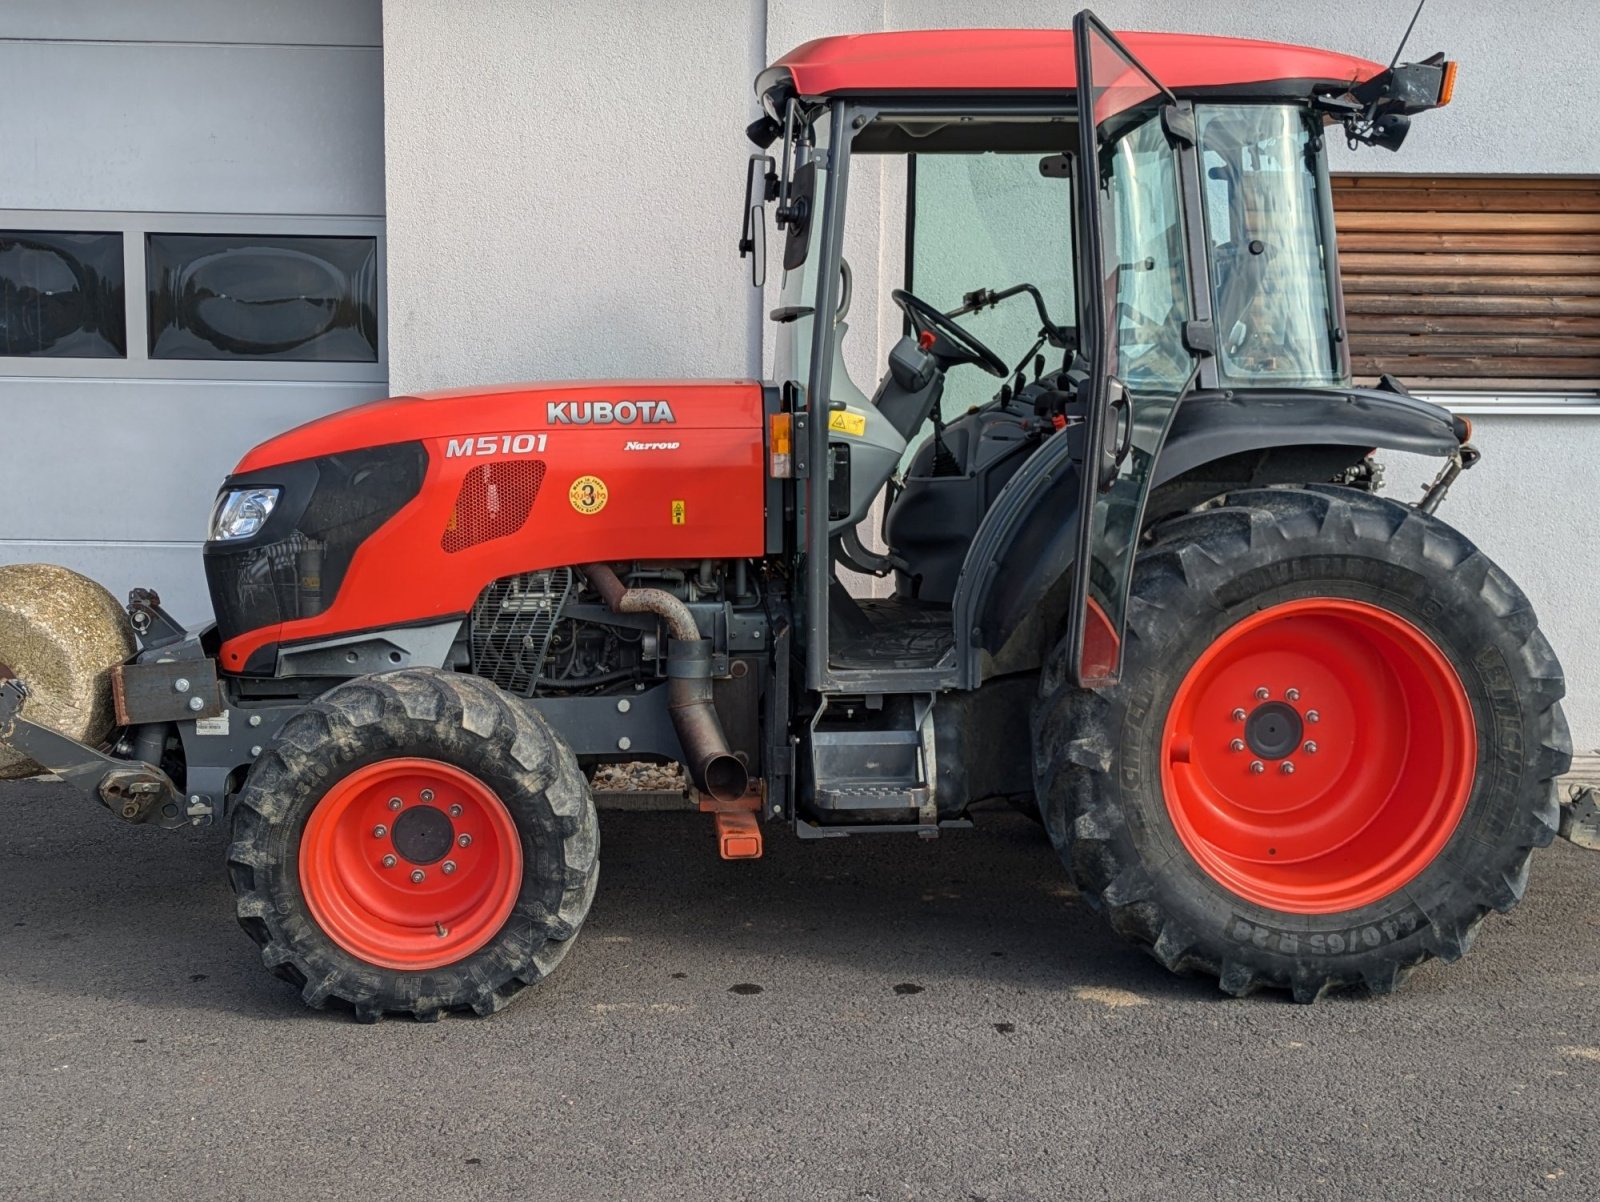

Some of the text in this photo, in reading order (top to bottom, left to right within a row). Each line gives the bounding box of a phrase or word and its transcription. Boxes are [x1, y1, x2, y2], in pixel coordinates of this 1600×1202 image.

[547, 400, 676, 425] KUBOTA
[446, 433, 548, 458] M5101
[624, 441, 680, 451] Narrow
[582, 485, 594, 506] 3
[1232, 911, 1417, 954] 440/65 R 28
